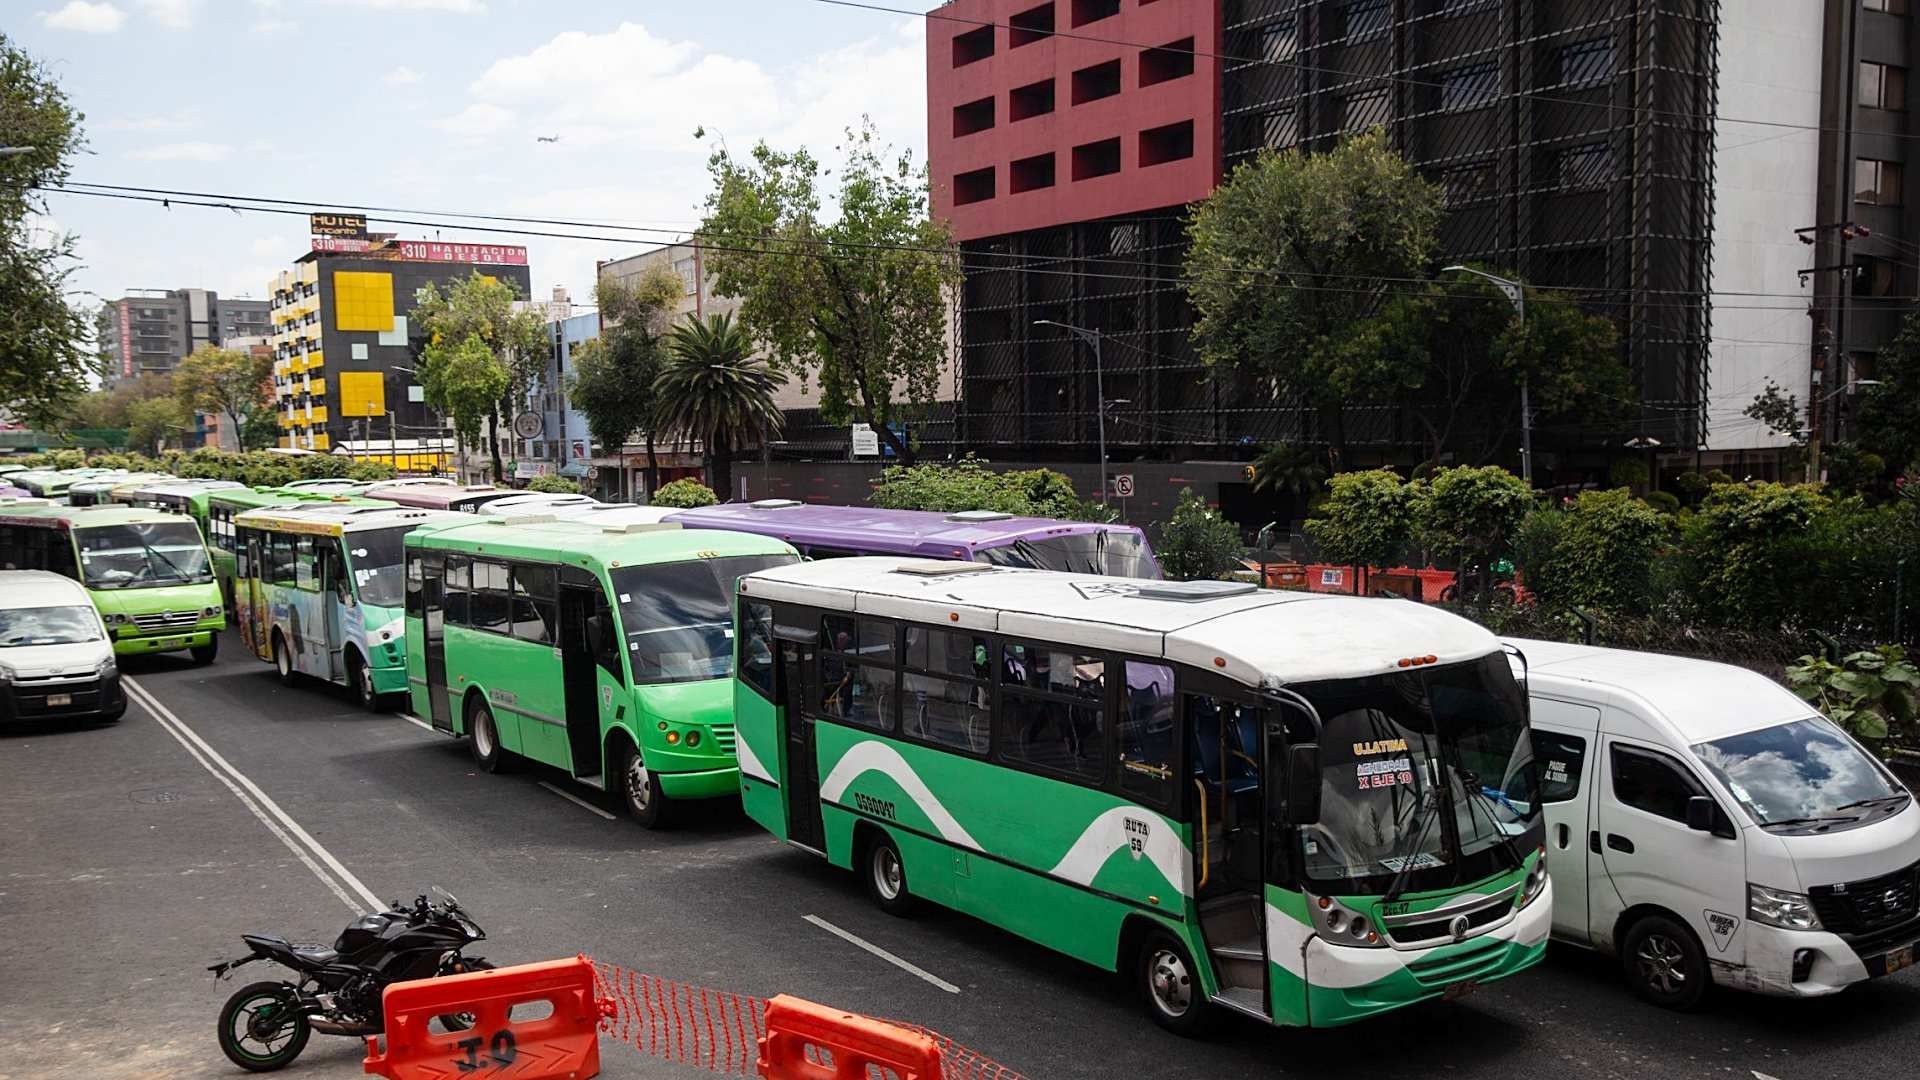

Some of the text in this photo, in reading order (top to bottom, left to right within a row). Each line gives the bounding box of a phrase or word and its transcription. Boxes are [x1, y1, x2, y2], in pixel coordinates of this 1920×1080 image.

[432, 245, 526, 256] HABITACION
[444, 252, 505, 262] DESDE
[1371, 773, 1395, 788] EJE
[1125, 819, 1148, 836] RUTA
[1131, 838, 1142, 852] 59
